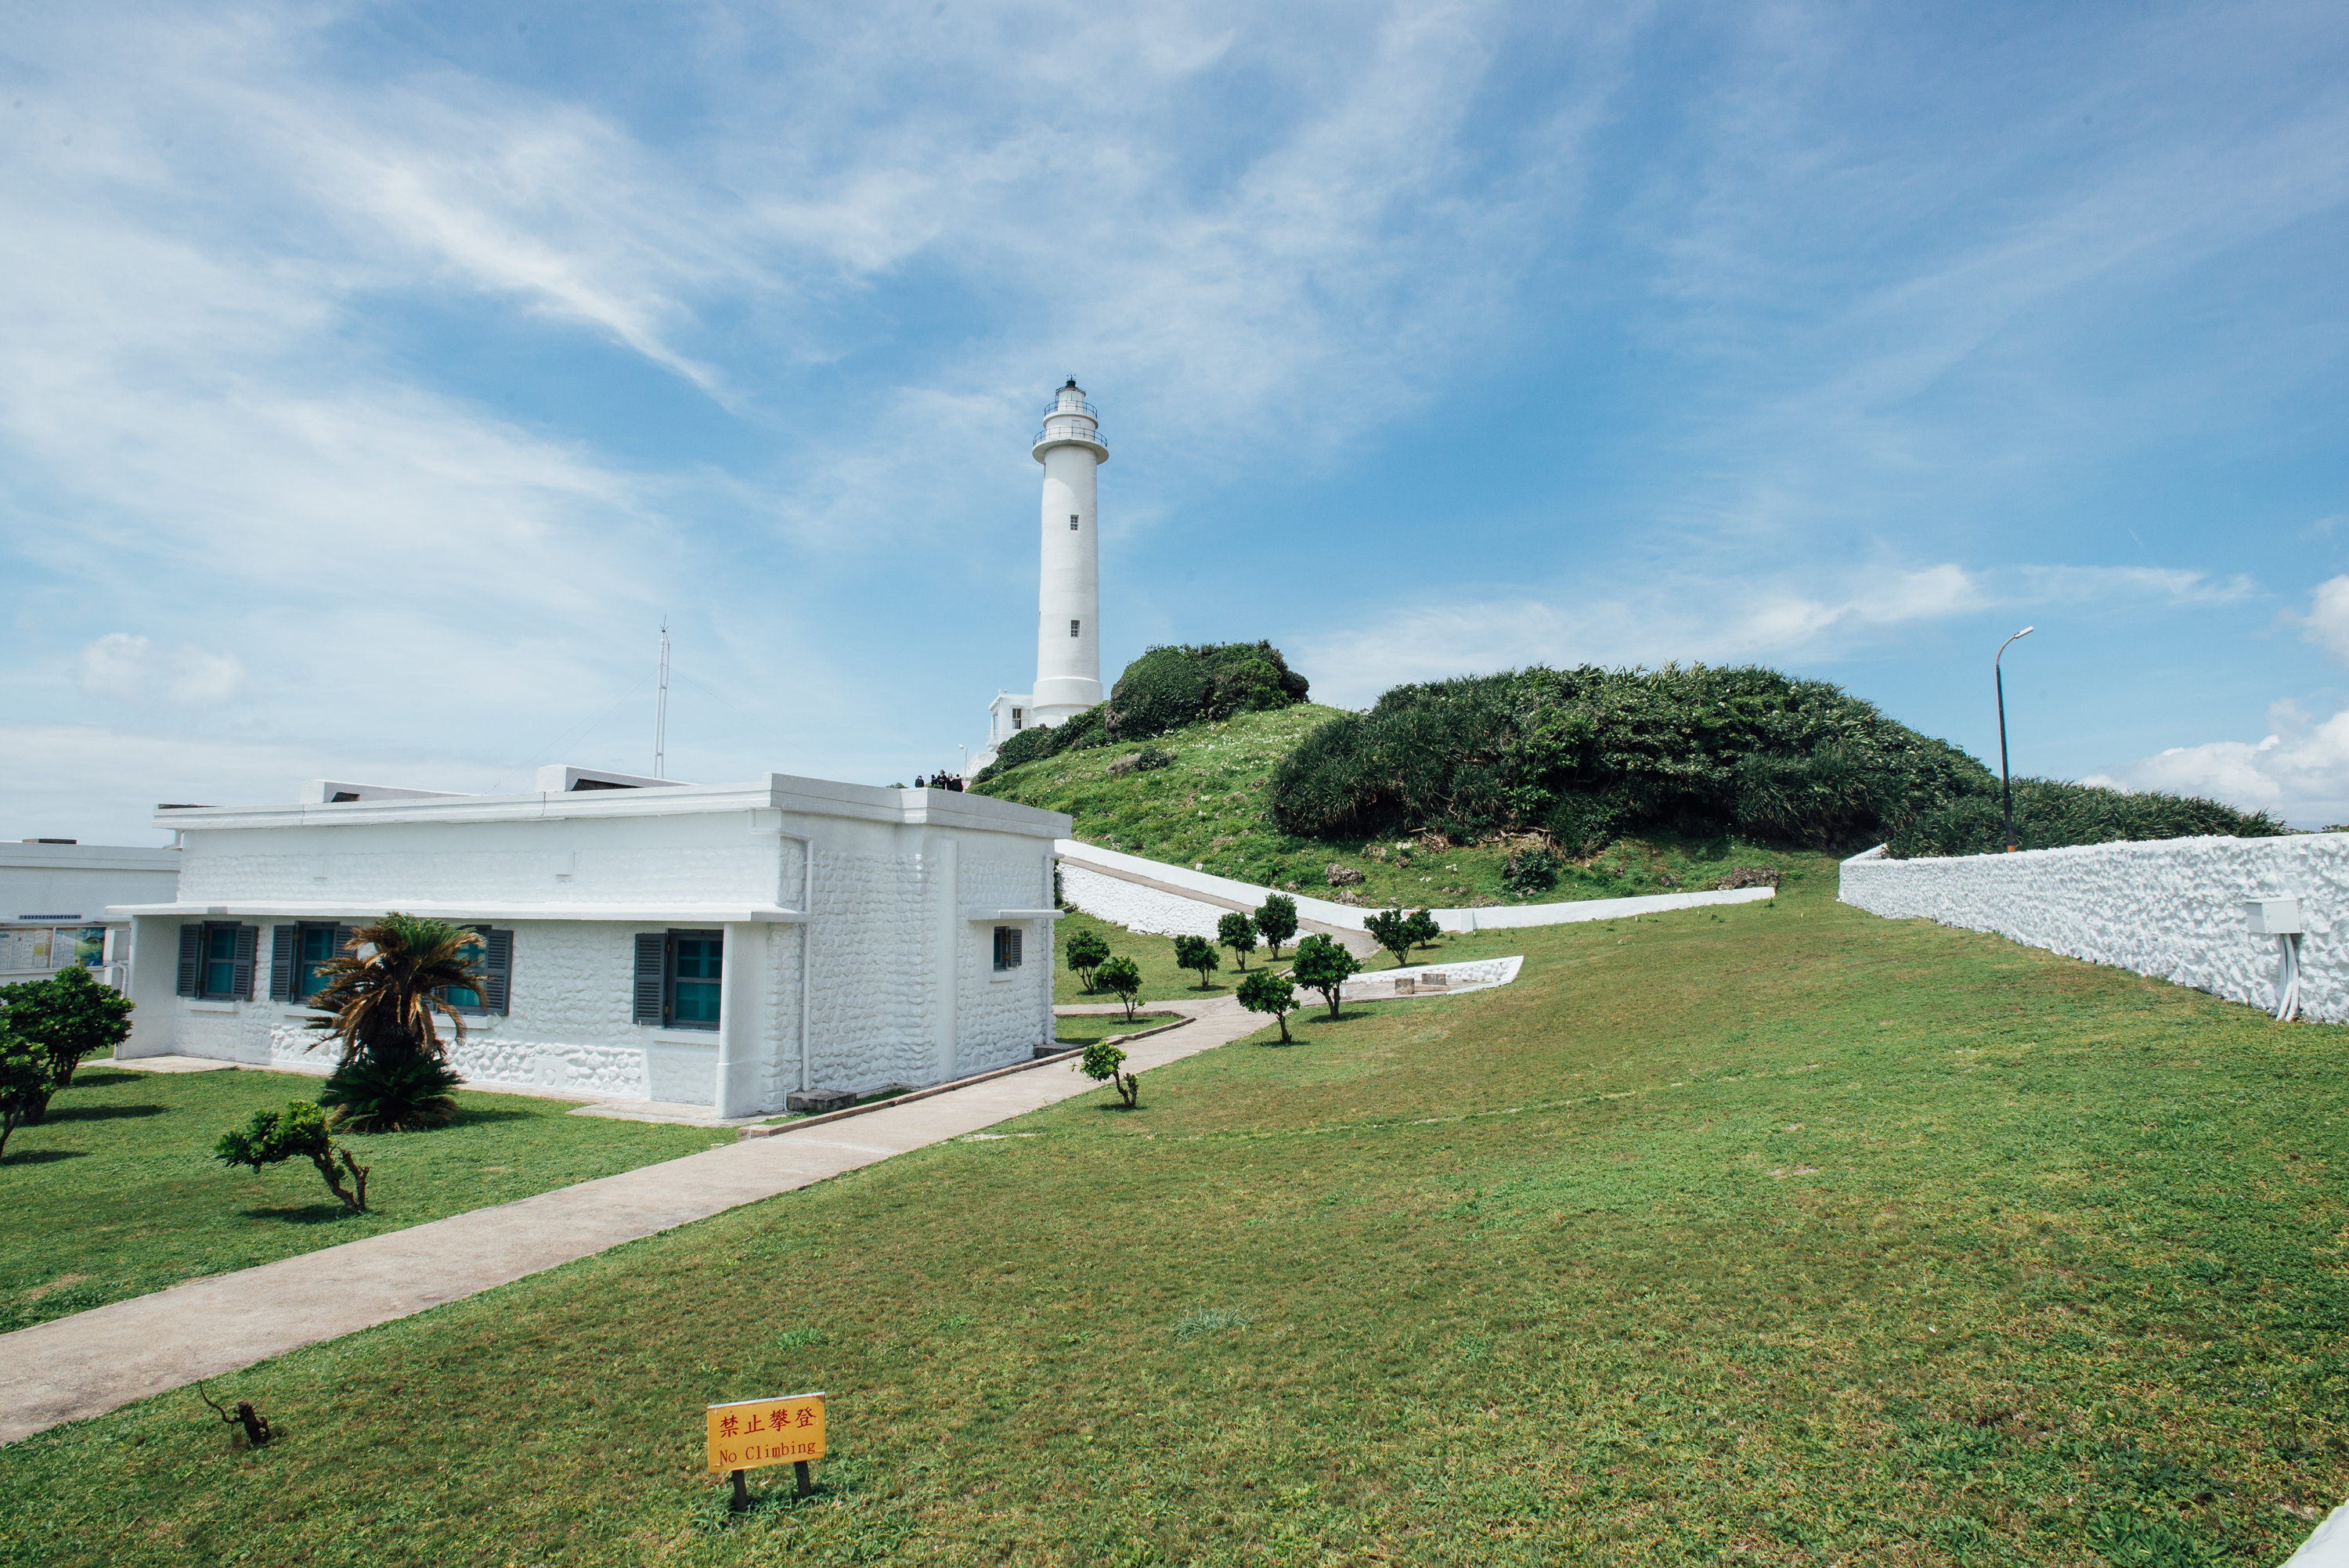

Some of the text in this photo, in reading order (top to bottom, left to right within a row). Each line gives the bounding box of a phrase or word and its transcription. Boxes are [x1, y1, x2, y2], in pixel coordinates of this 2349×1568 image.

[719, 1407, 816, 1438] 禁止攀登
[720, 1441, 816, 1464] No Climbing
